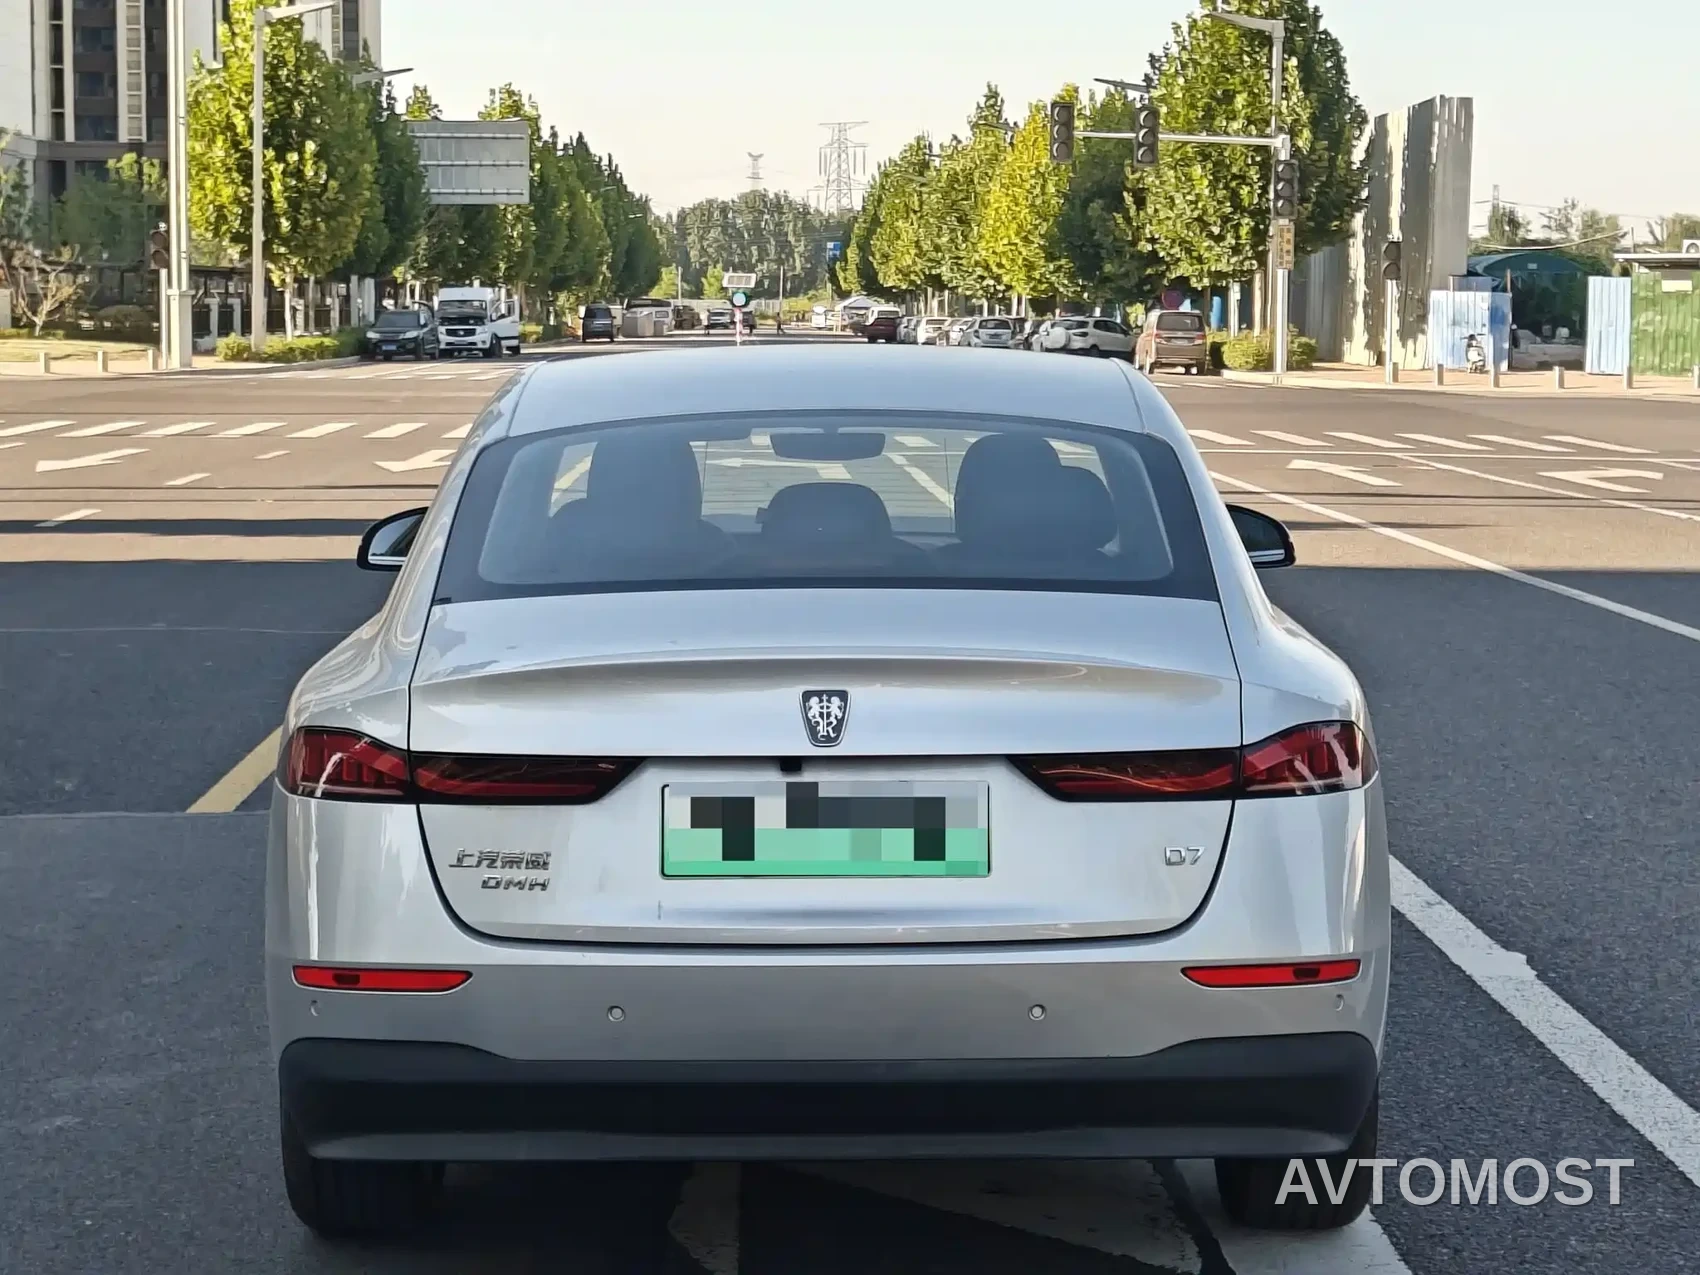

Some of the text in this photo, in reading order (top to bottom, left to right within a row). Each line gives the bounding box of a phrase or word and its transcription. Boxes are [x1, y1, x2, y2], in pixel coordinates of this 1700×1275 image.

[448, 848, 551, 870] 上汽荣威
[1164, 846, 1205, 866] D7
[481, 875, 550, 891] DMH
